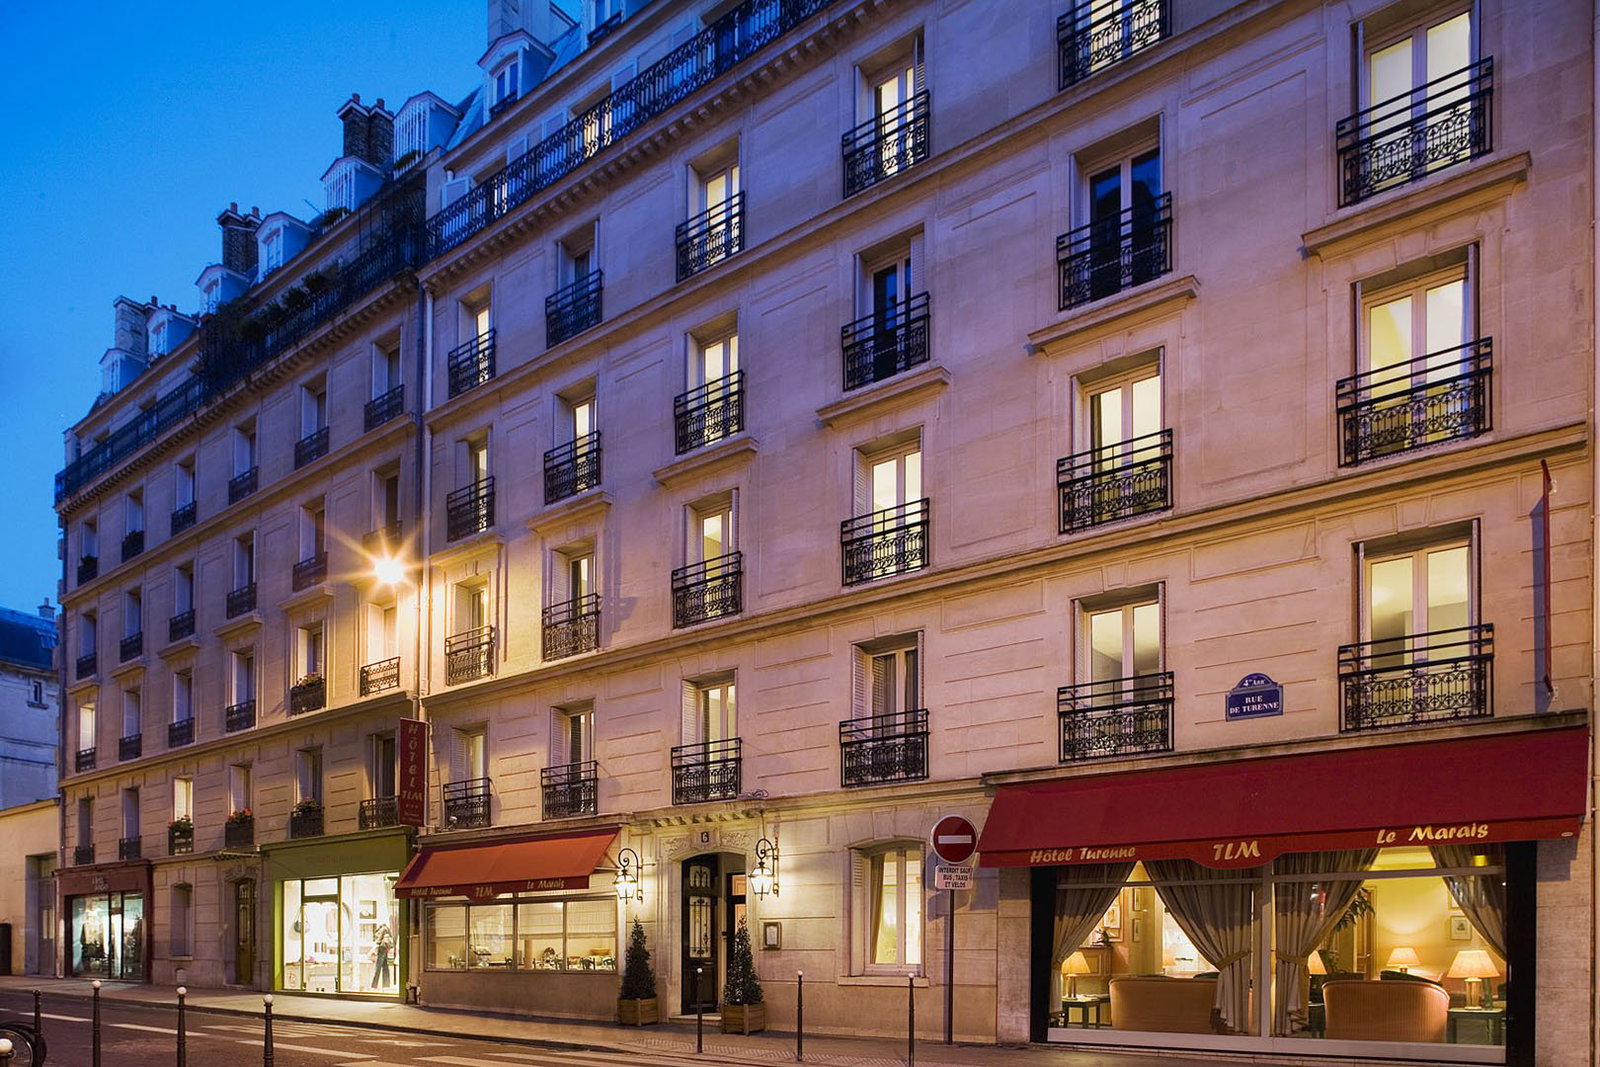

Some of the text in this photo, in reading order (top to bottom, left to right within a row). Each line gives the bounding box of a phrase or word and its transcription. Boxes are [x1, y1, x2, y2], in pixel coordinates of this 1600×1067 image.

[1245, 695, 1263, 704] RUE
[1229, 701, 1279, 714] DE TURENNE
[702, 832, 708, 842] 6
[1376, 822, 1489, 844] Le Marais
[1030, 846, 1136, 863] Hôtel Turenne
[1213, 840, 1261, 861] TLM
[475, 886, 494, 898] TLM
